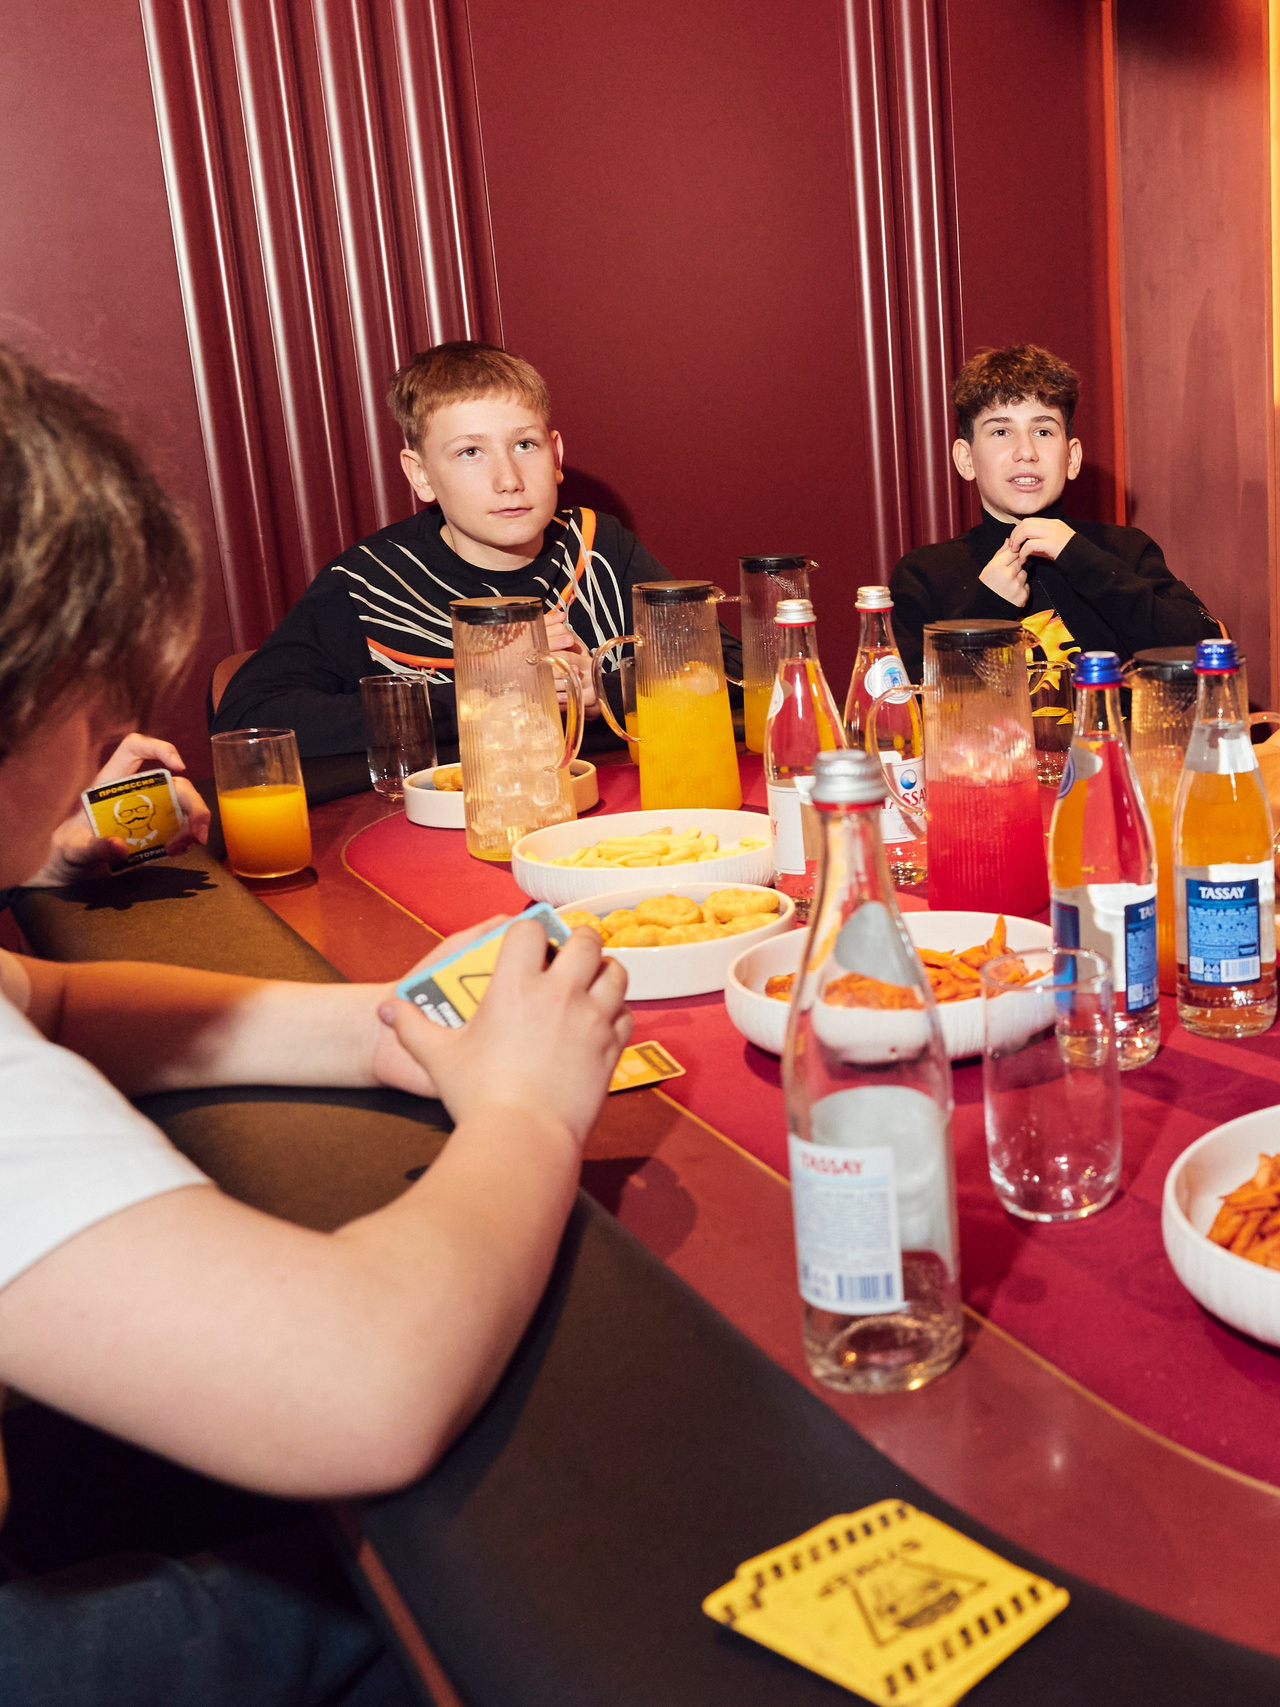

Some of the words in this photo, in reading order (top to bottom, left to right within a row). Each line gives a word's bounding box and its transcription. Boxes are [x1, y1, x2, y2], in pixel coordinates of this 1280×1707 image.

[99, 778, 155, 798] ПРОФЕССИЯ
[1198, 886, 1246, 900] TASSAY
[801, 1152, 864, 1175] TASSAY
